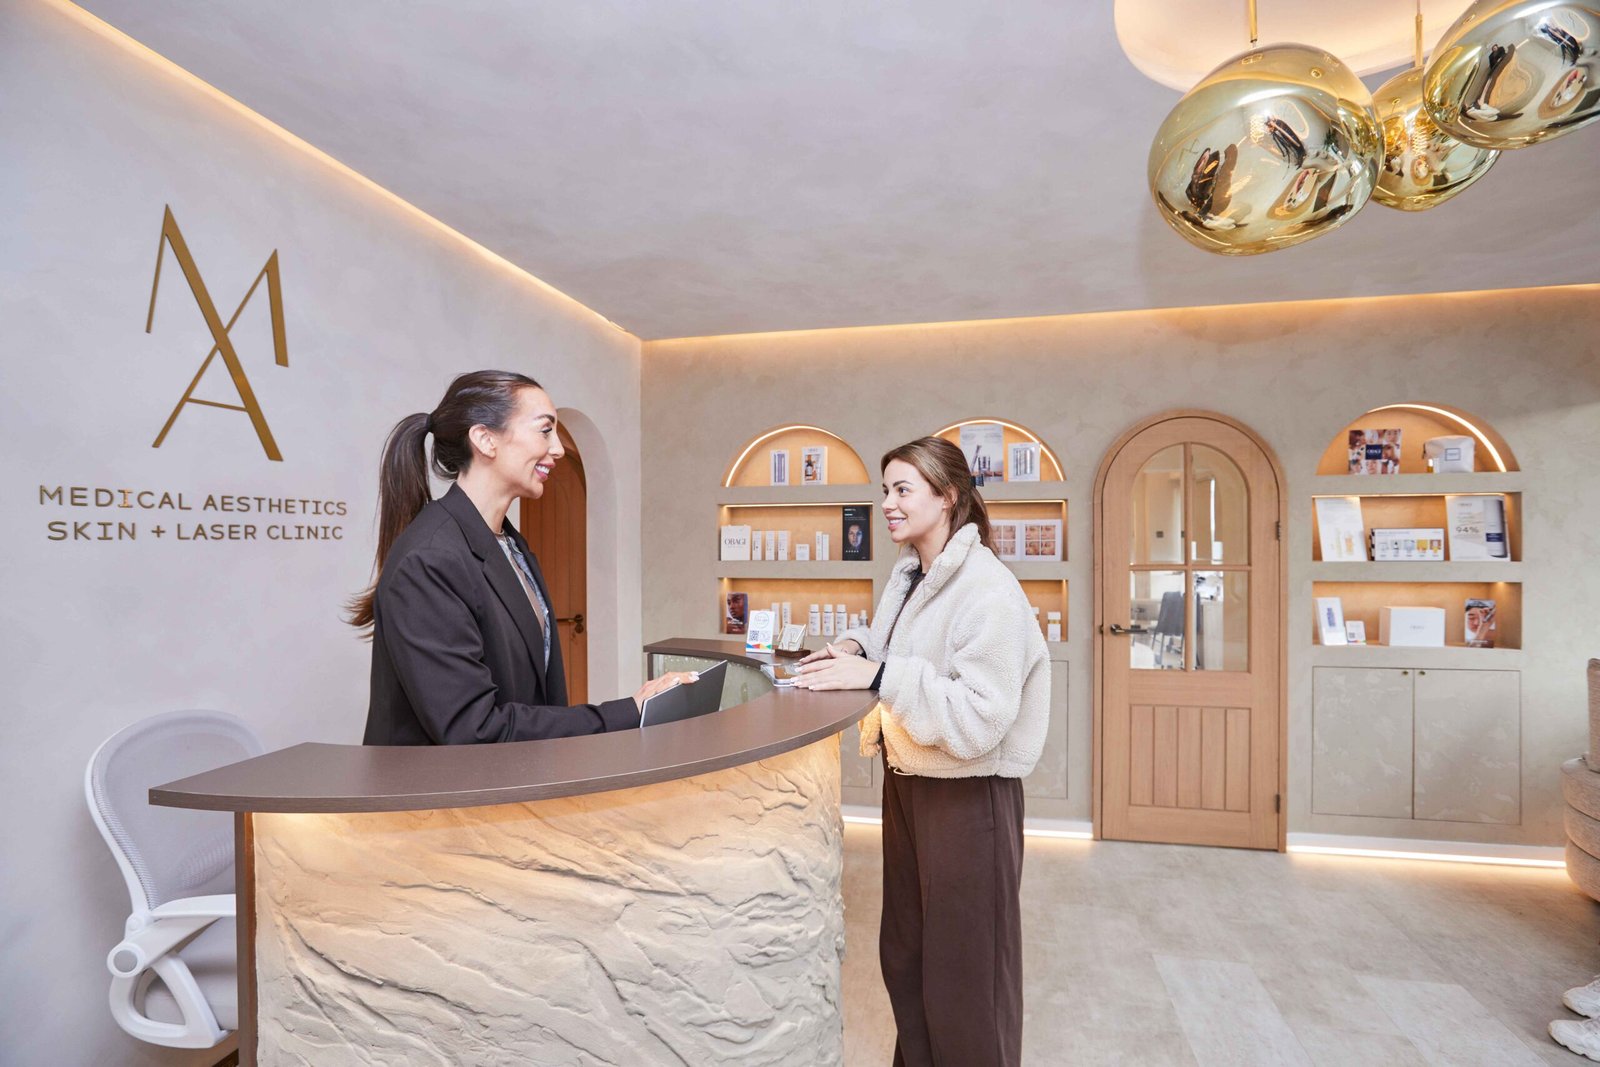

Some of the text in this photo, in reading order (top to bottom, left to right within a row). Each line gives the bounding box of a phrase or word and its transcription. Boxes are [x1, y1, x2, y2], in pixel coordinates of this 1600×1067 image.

[39, 485, 347, 516] MEDICAL AESTHETICS
[47, 521, 137, 541] SKIN
[177, 523, 257, 541] LASER
[266, 524, 343, 541] CLINIC
[724, 537, 747, 545] OBAGI
